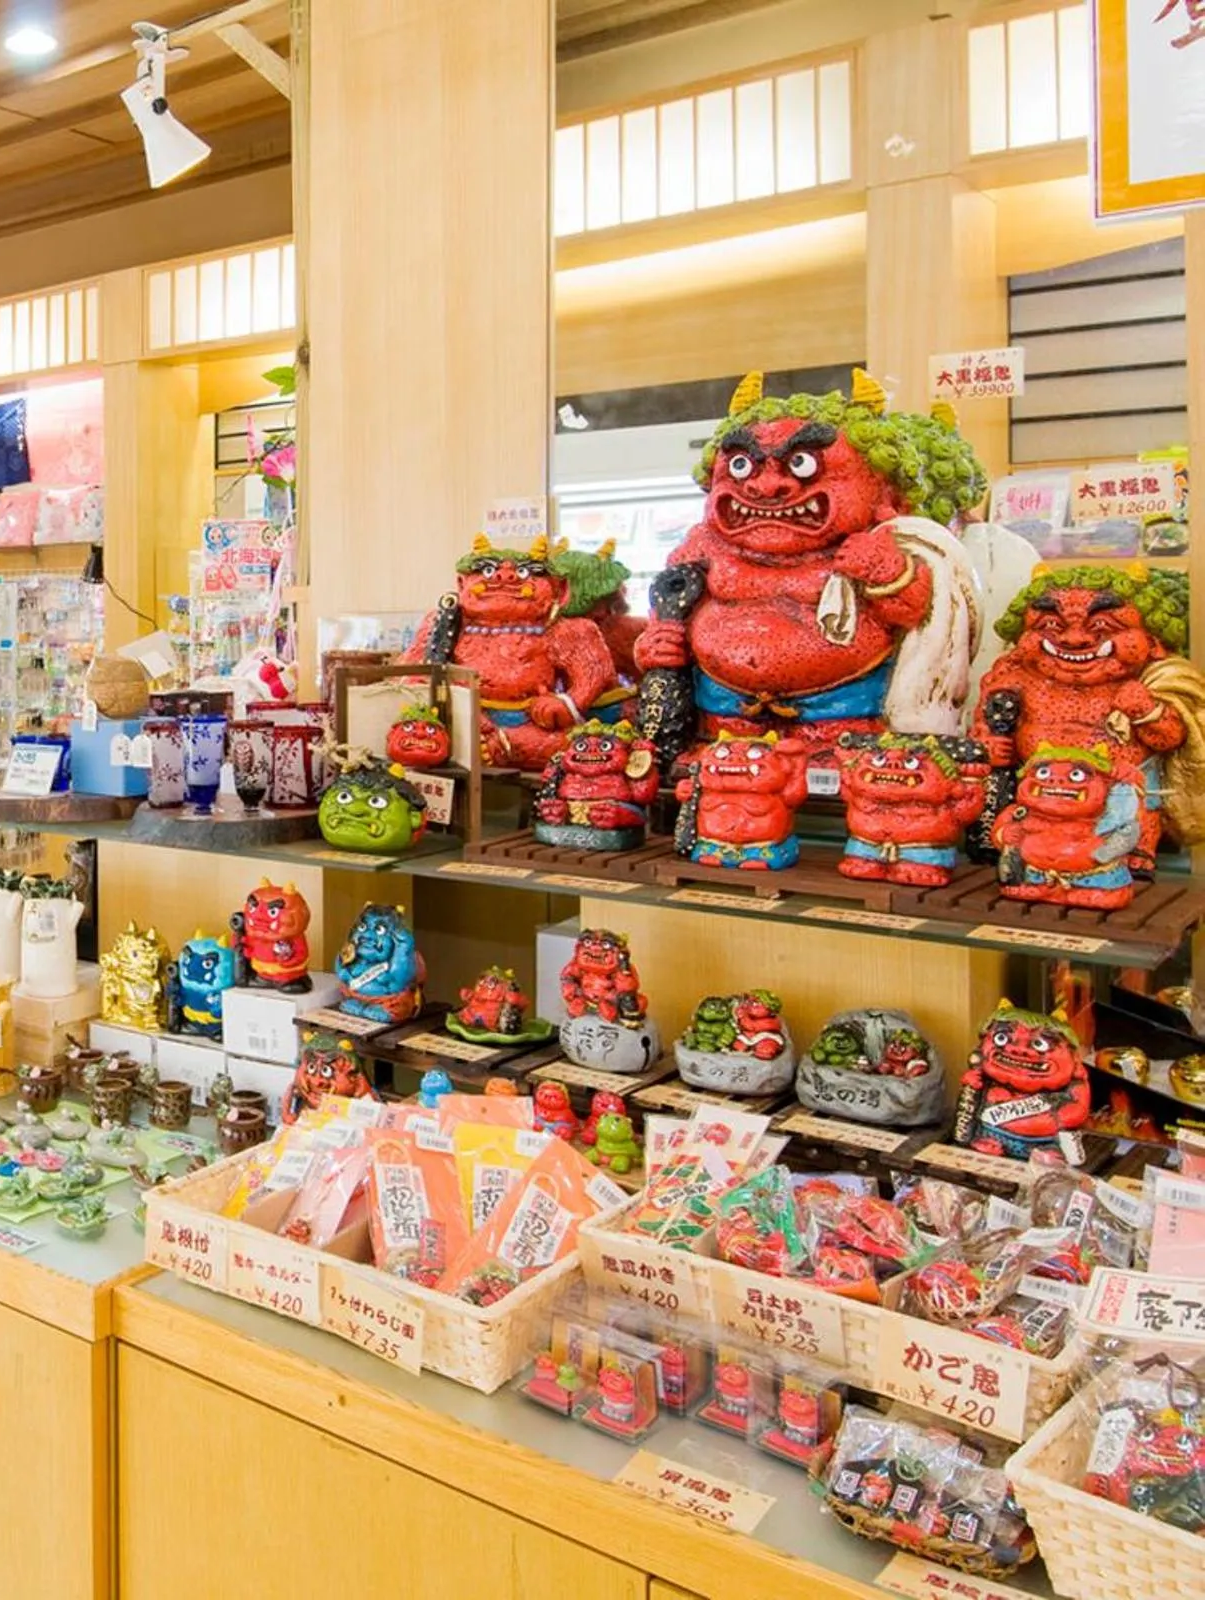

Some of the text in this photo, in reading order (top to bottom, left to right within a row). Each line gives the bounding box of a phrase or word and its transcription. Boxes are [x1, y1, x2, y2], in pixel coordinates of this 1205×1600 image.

[902, 1341, 1001, 1399] かご鬼
[918, 1384, 996, 1428] ¥420
